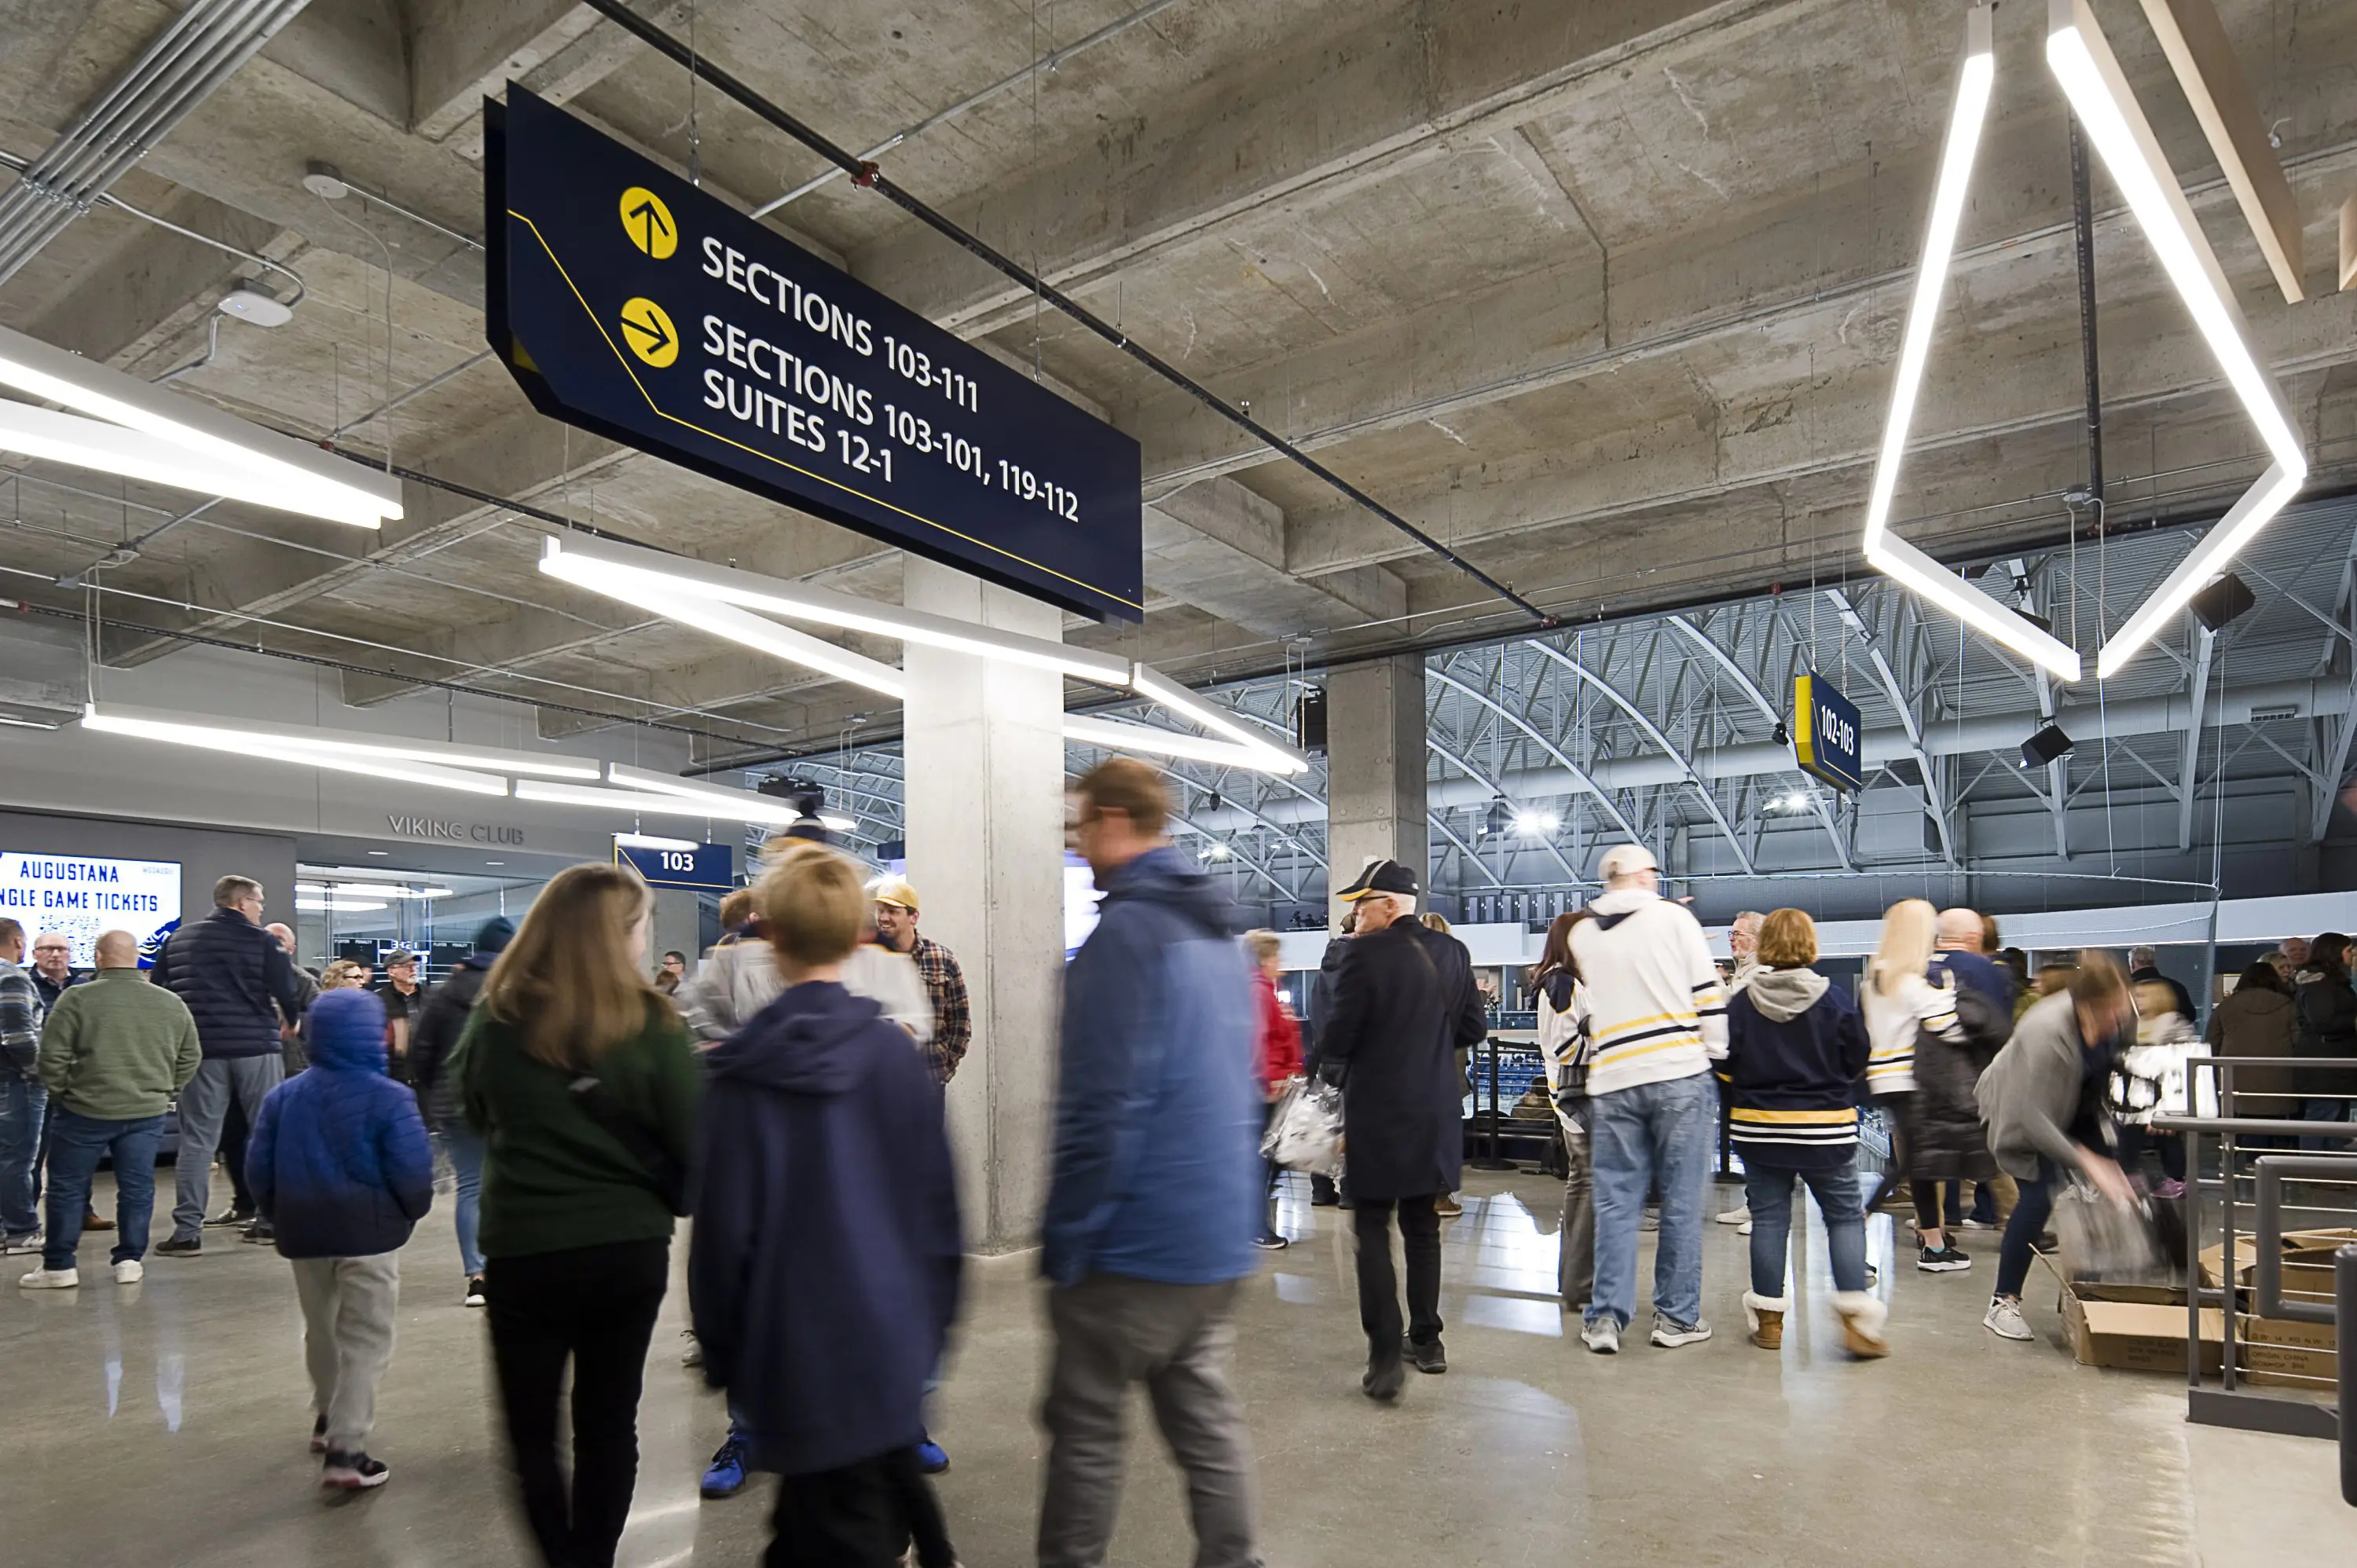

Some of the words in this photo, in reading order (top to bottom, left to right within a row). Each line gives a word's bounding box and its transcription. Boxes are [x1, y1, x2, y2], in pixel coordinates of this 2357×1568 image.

[702, 236, 873, 357] SECTIONS
[883, 335, 977, 413] 103-111
[703, 314, 874, 426] SECTIONS
[884, 404, 991, 485] 103-101,
[999, 460, 1079, 523] 119-112
[703, 368, 826, 452] SUITES
[837, 430, 892, 483] 12-1
[1821, 705, 1854, 757] 102-103
[388, 815, 464, 840] VIKING
[471, 824, 525, 845] CLUB
[20, 860, 119, 883] AUGUSTANA
[660, 851, 695, 872] 103
[44, 890, 88, 909] GAME
[96, 892, 159, 912] TICKETS
